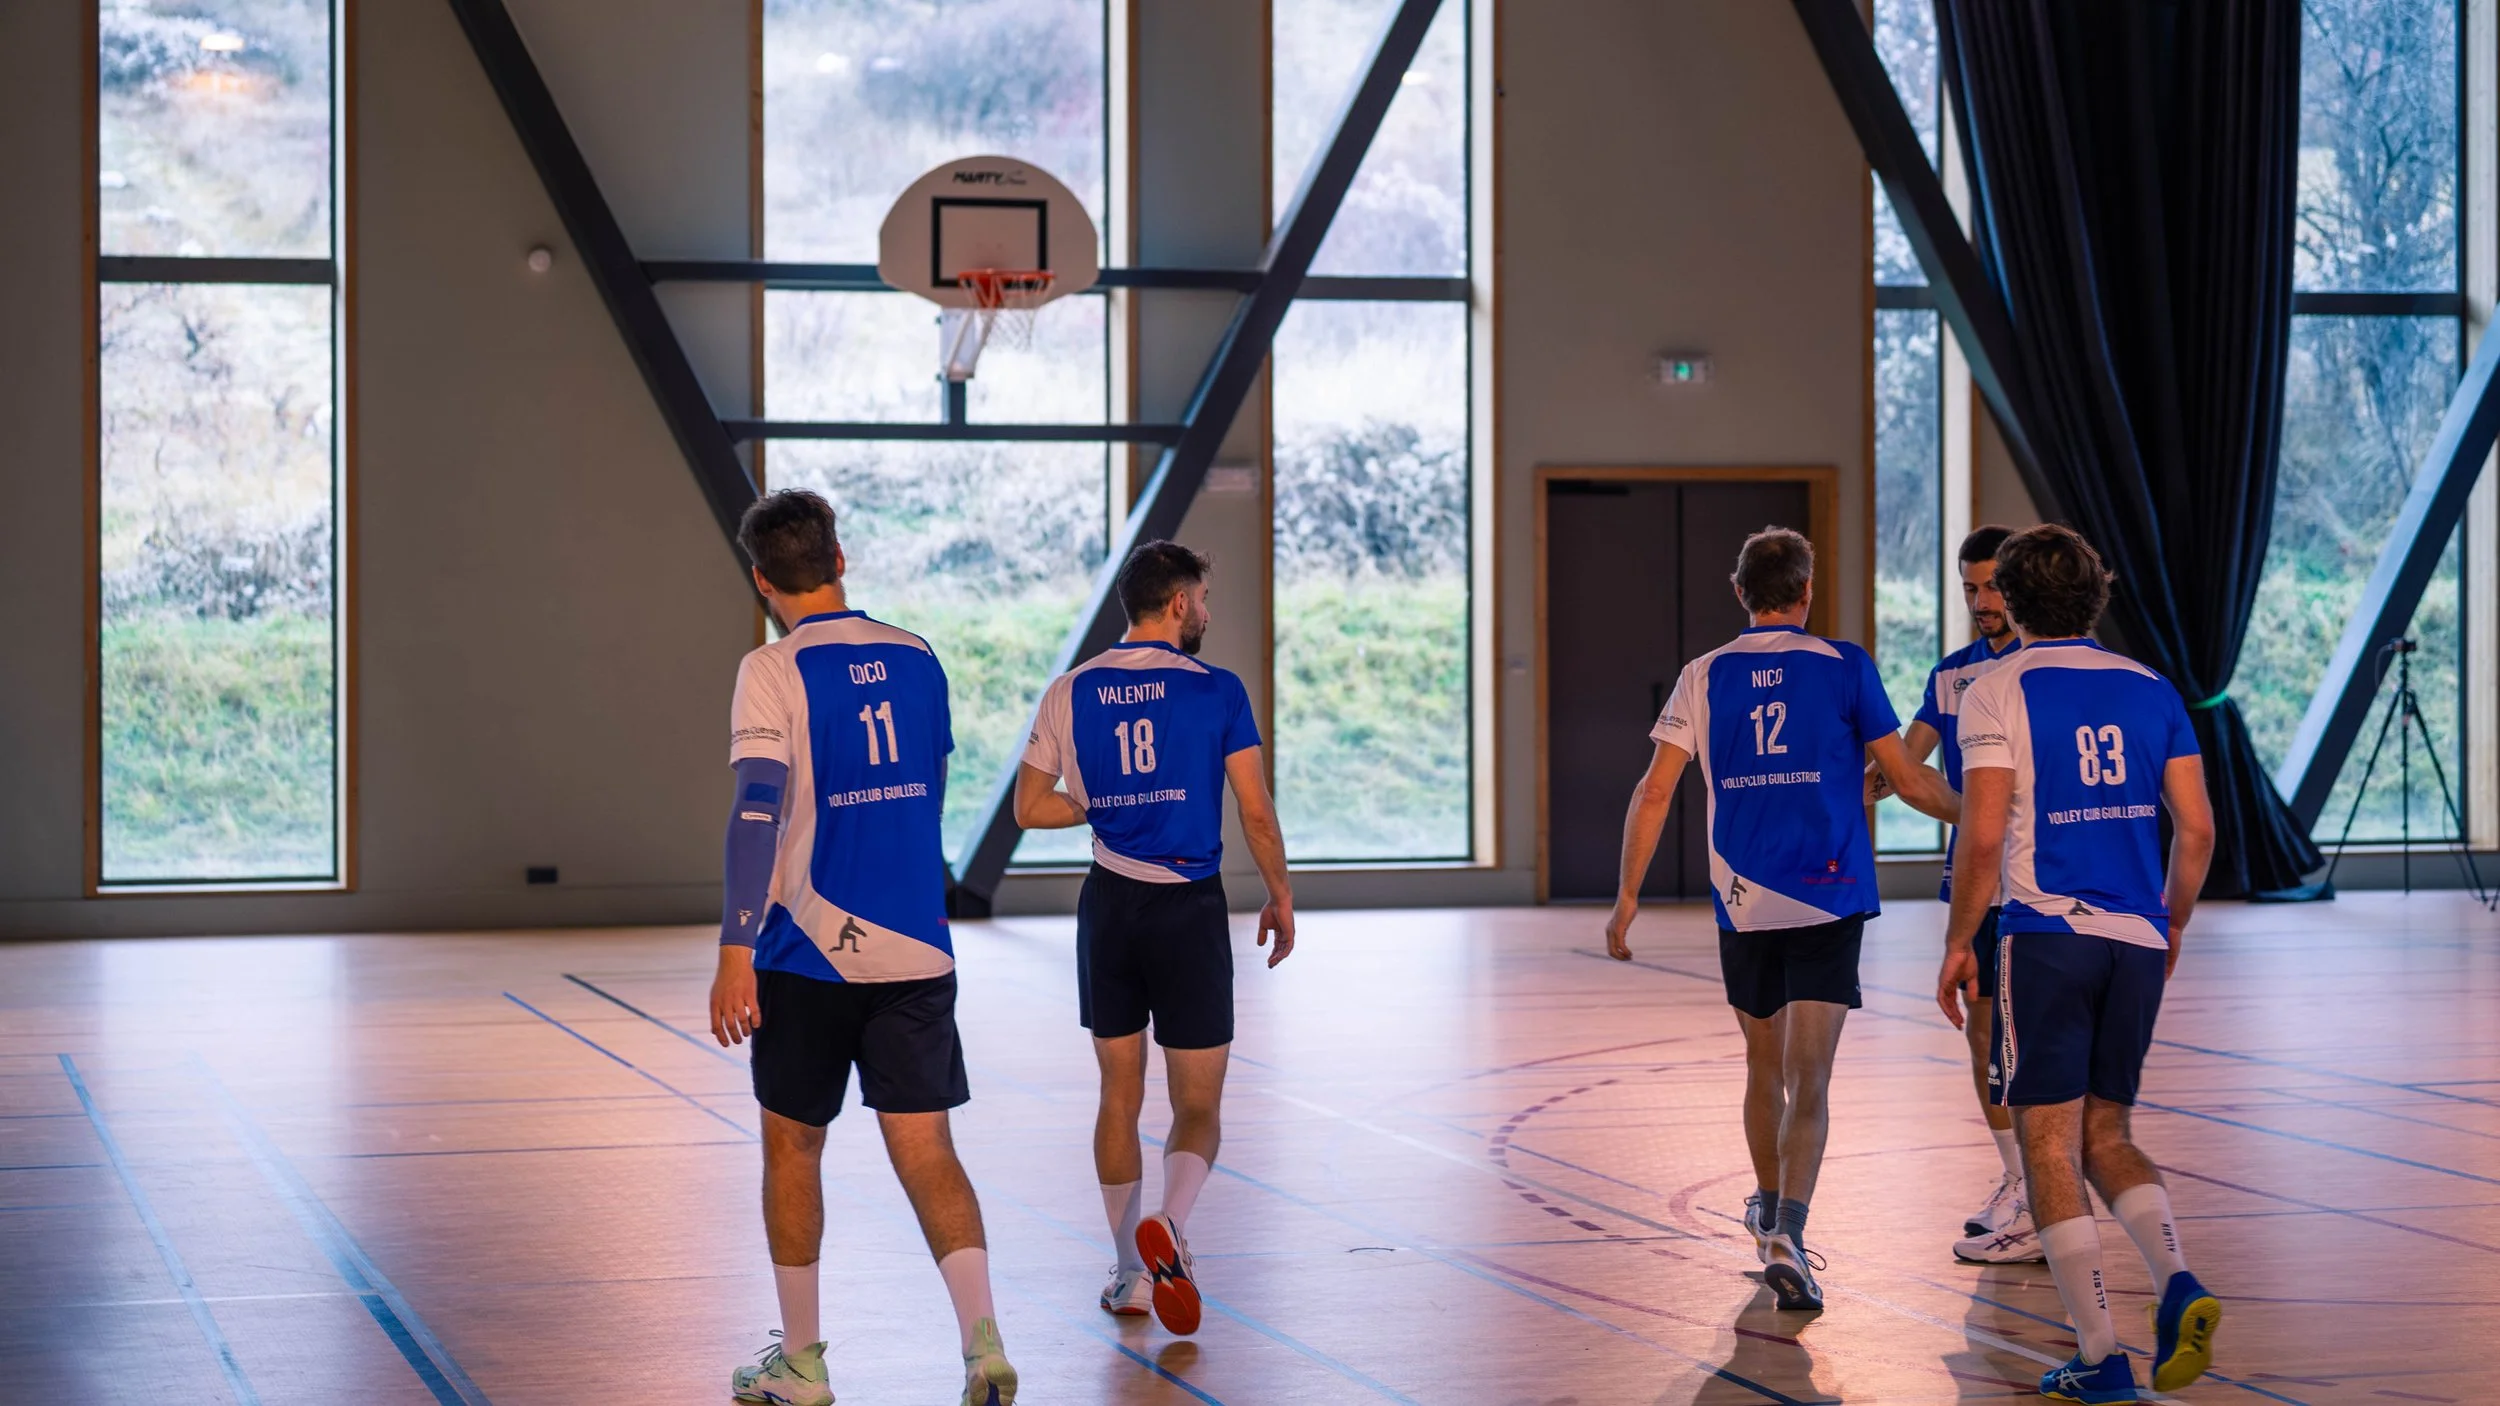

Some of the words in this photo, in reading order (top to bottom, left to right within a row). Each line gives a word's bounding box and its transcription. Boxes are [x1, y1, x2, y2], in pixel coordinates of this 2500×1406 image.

[1097, 681, 1165, 705] VALENTIN
[1751, 668, 1783, 688] NICO
[859, 700, 900, 766] 11
[1114, 718, 1156, 776] 18
[1750, 701, 1788, 756] 12
[2075, 724, 2126, 787] 83
[1091, 795, 1113, 809] OLLE
[1114, 793, 1137, 807] CLUB
[1138, 788, 1186, 805] GLLESTROIS
[1720, 776, 1748, 789] VOLLEY
[1748, 774, 1767, 787] CLUB
[1768, 771, 1821, 785] GUILLESTROIS
